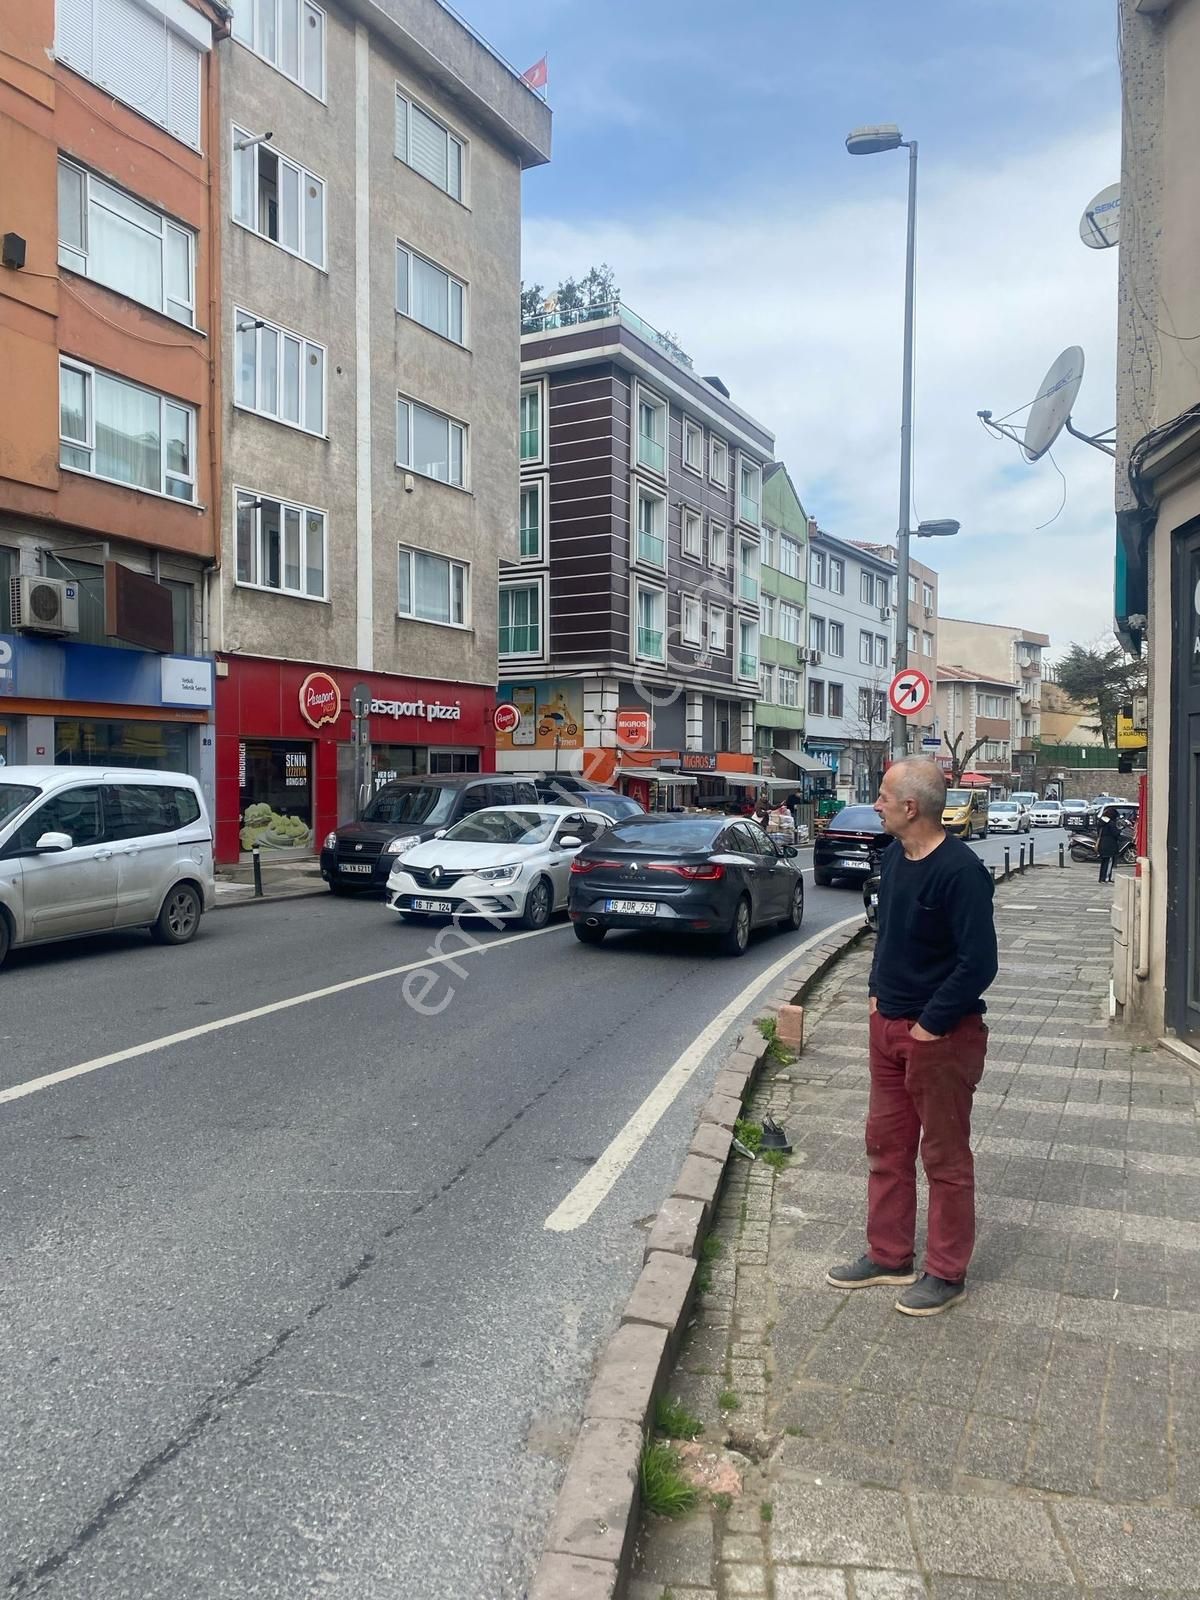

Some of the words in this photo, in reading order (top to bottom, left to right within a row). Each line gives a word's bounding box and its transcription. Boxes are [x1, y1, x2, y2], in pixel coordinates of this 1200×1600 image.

[307, 688, 334, 707] Pasaport
[370, 699, 425, 719] asaport
[427, 701, 461, 722] pizza
[415, 900, 422, 909] 16
[426, 902, 434, 910] TF
[438, 903, 450, 912] 124
[612, 901, 618, 910] 16
[622, 902, 636, 911] ADR
[640, 903, 654, 912] 755
